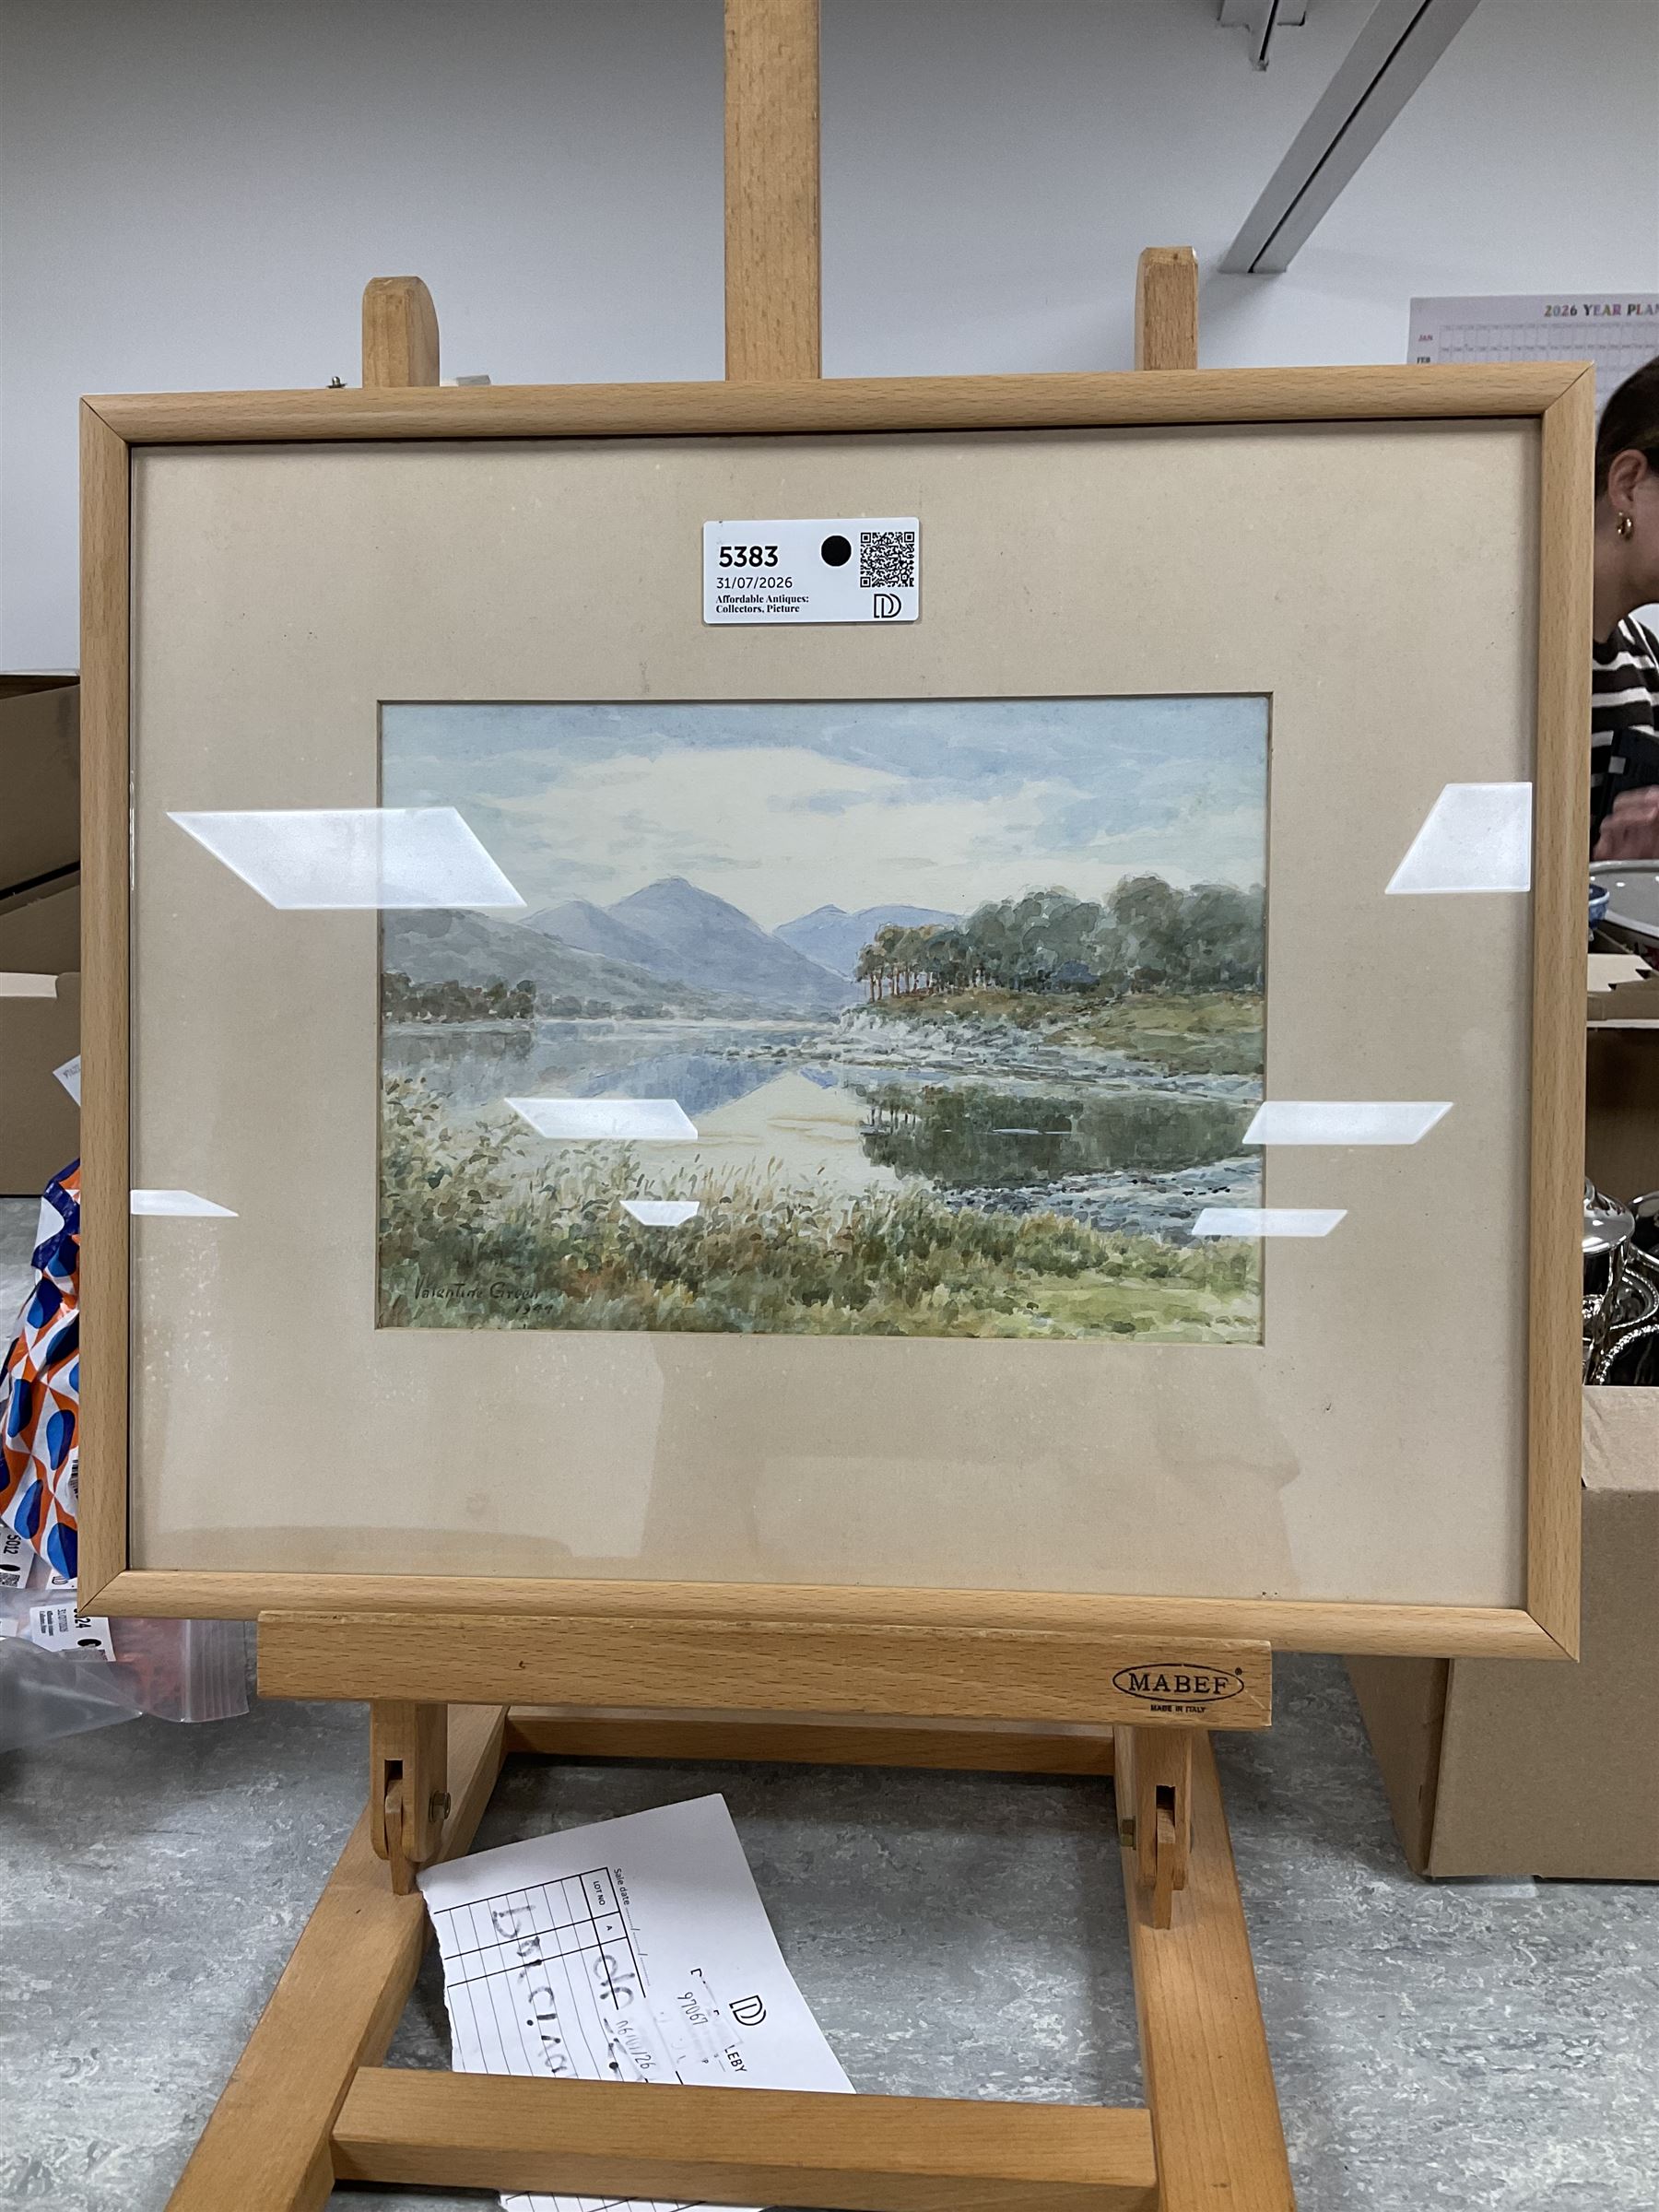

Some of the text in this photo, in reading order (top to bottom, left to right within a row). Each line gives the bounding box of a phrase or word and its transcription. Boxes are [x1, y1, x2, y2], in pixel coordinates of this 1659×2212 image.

[1544, 304, 1578, 317] 2026
[1583, 303, 1621, 316] YEAR
[718, 545, 779, 568] 5383
[716, 576, 794, 589] 31/07/2026
[715, 594, 809, 605] Affordable Antiques:
[715, 604, 800, 614] Collectors, Picture
[3, 1534, 21, 1555] 5012
[1127, 1673, 1230, 1695] MABEF
[1185, 1705, 1207, 1713] ITALY
[593, 1880, 606, 1906] LOT NO
[614, 1867, 630, 1906] Sale date
[677, 1991, 709, 2026] 97067
